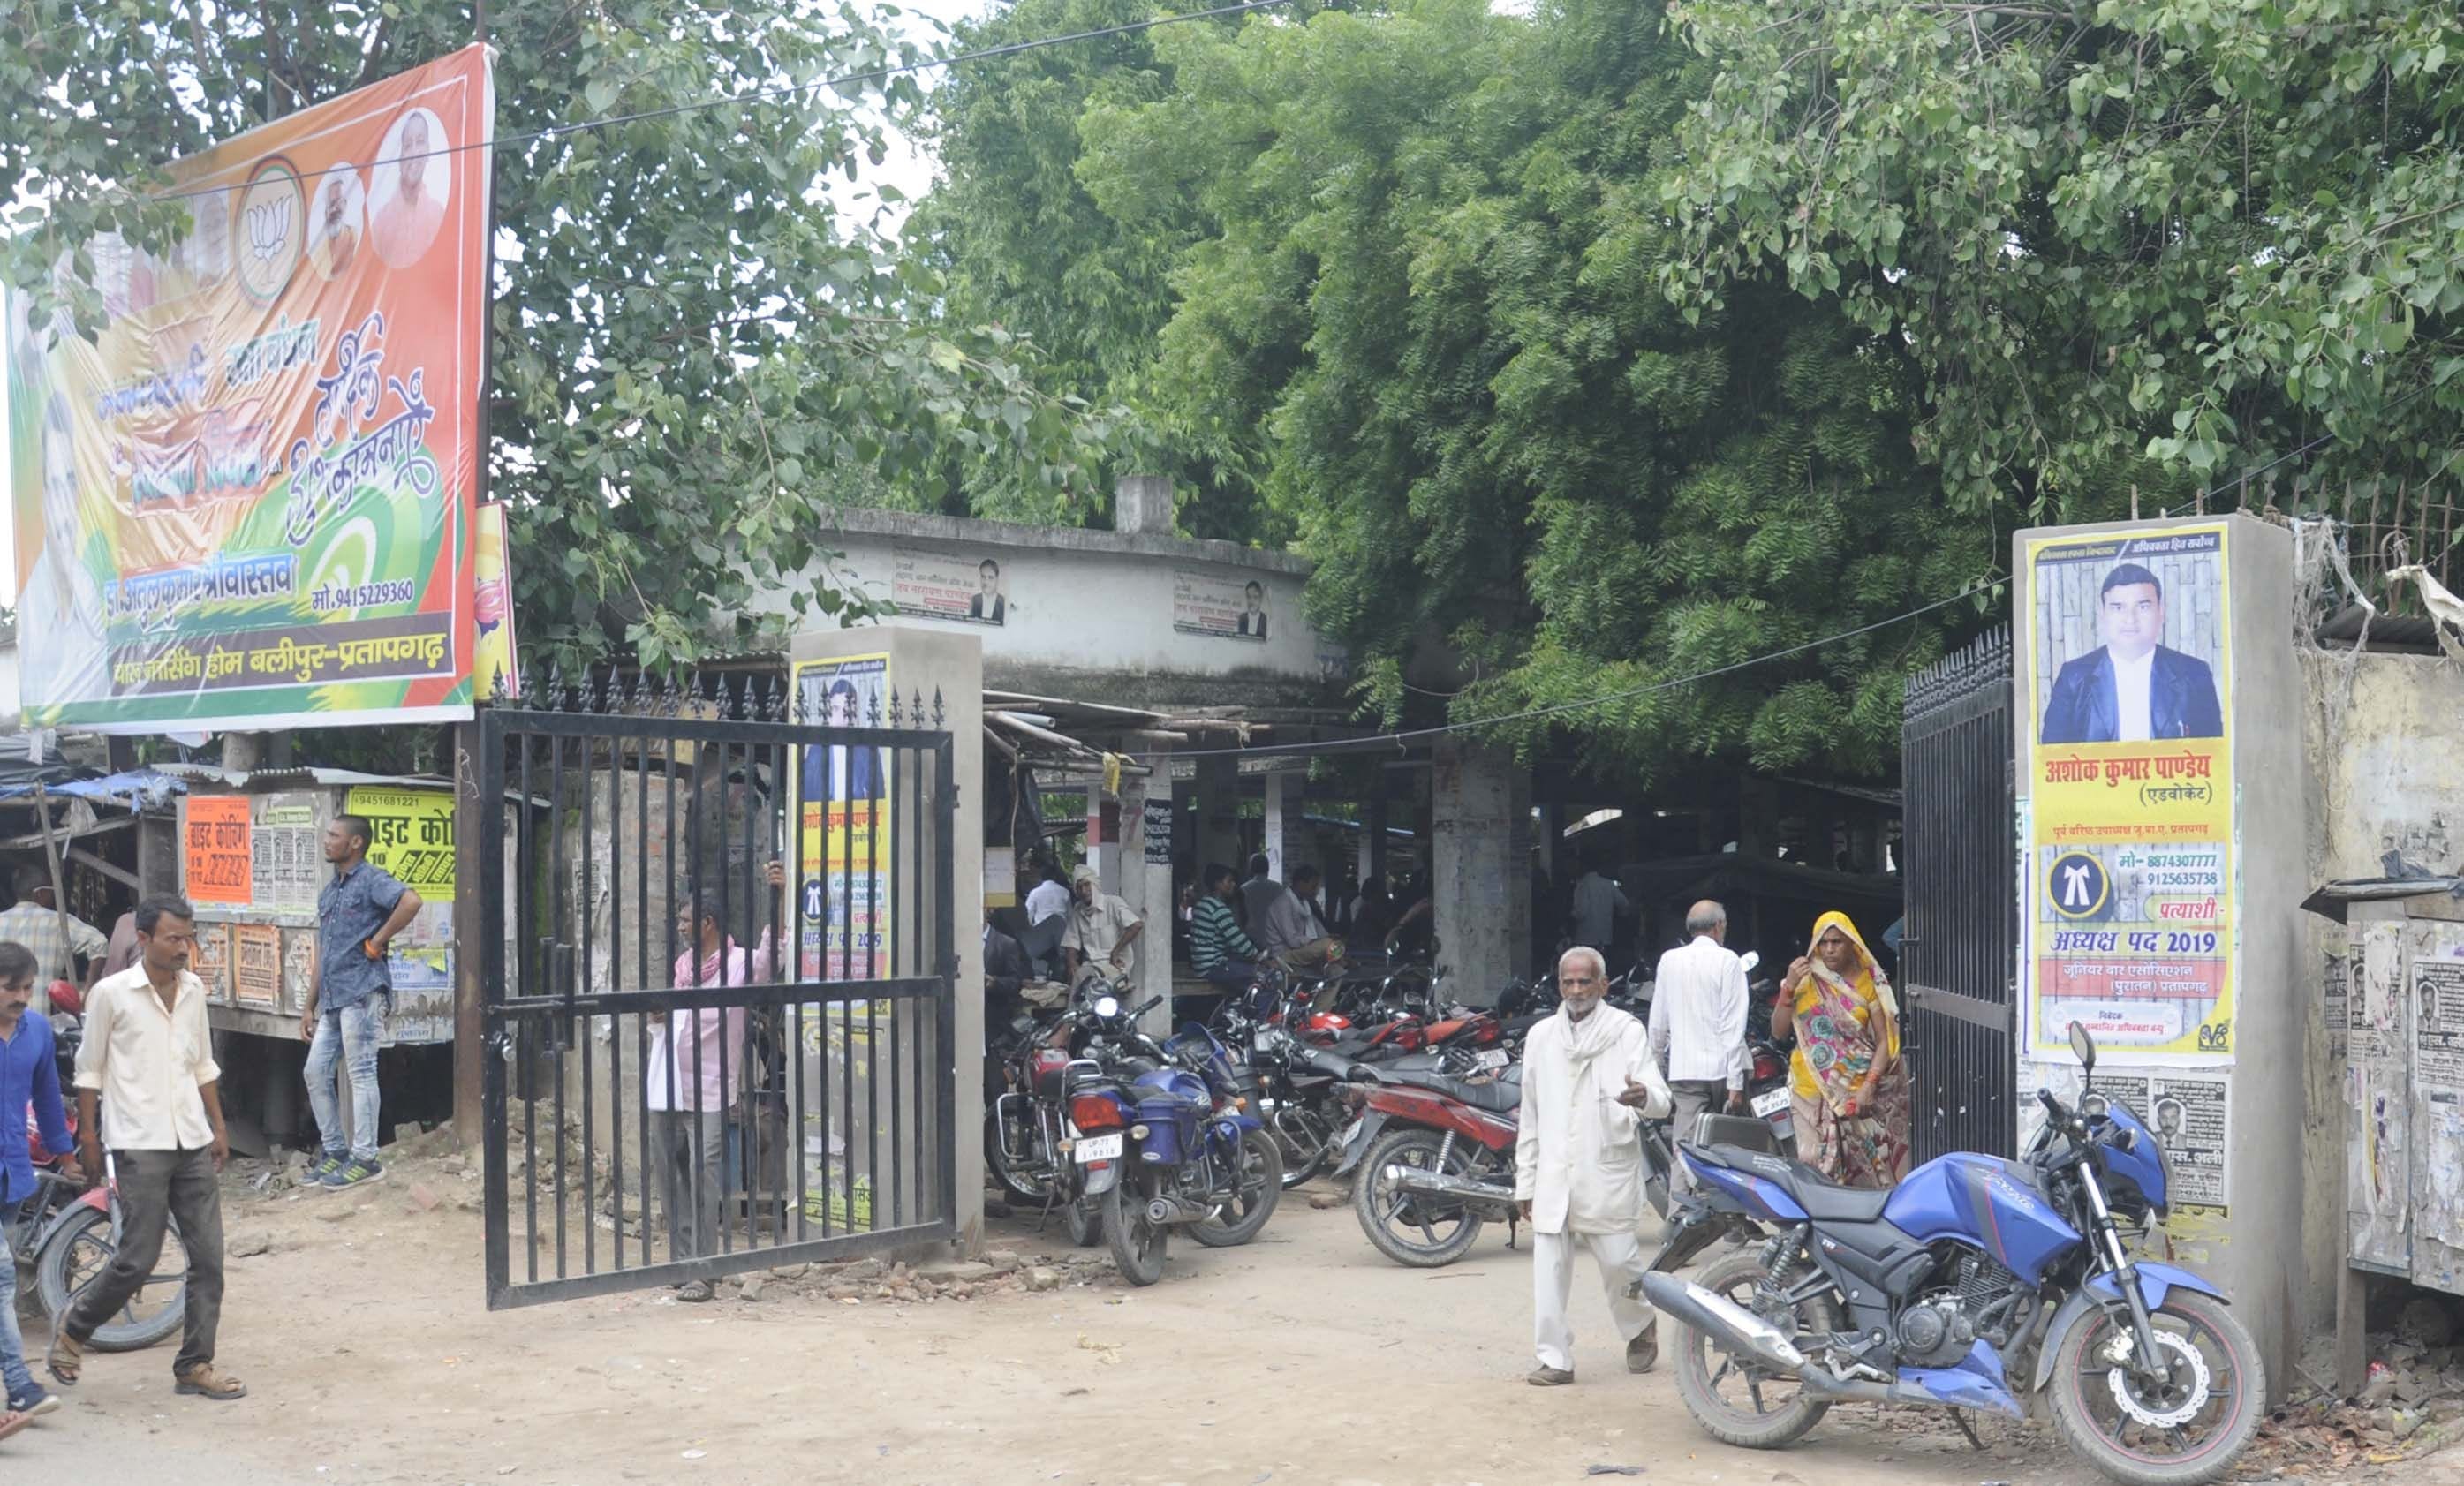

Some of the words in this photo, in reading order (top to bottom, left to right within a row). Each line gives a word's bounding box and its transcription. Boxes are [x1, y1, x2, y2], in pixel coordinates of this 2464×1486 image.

[2045, 754, 2100, 782] अशोक
[2105, 757, 2150, 787] कुमार
[2155, 750, 2212, 779] पाण्डेय
[2139, 781, 2213, 807] (एडवोकेट)
[2147, 854, 2218, 868] 8874307777
[2148, 872, 2218, 886] 9125635738
[2159, 897, 2217, 920] प्रत्याशी
[858, 932, 882, 947] 209
[2051, 931, 2119, 952] अध्यक्ष
[2128, 932, 2160, 952] पद
[2167, 932, 2217, 952] 2019
